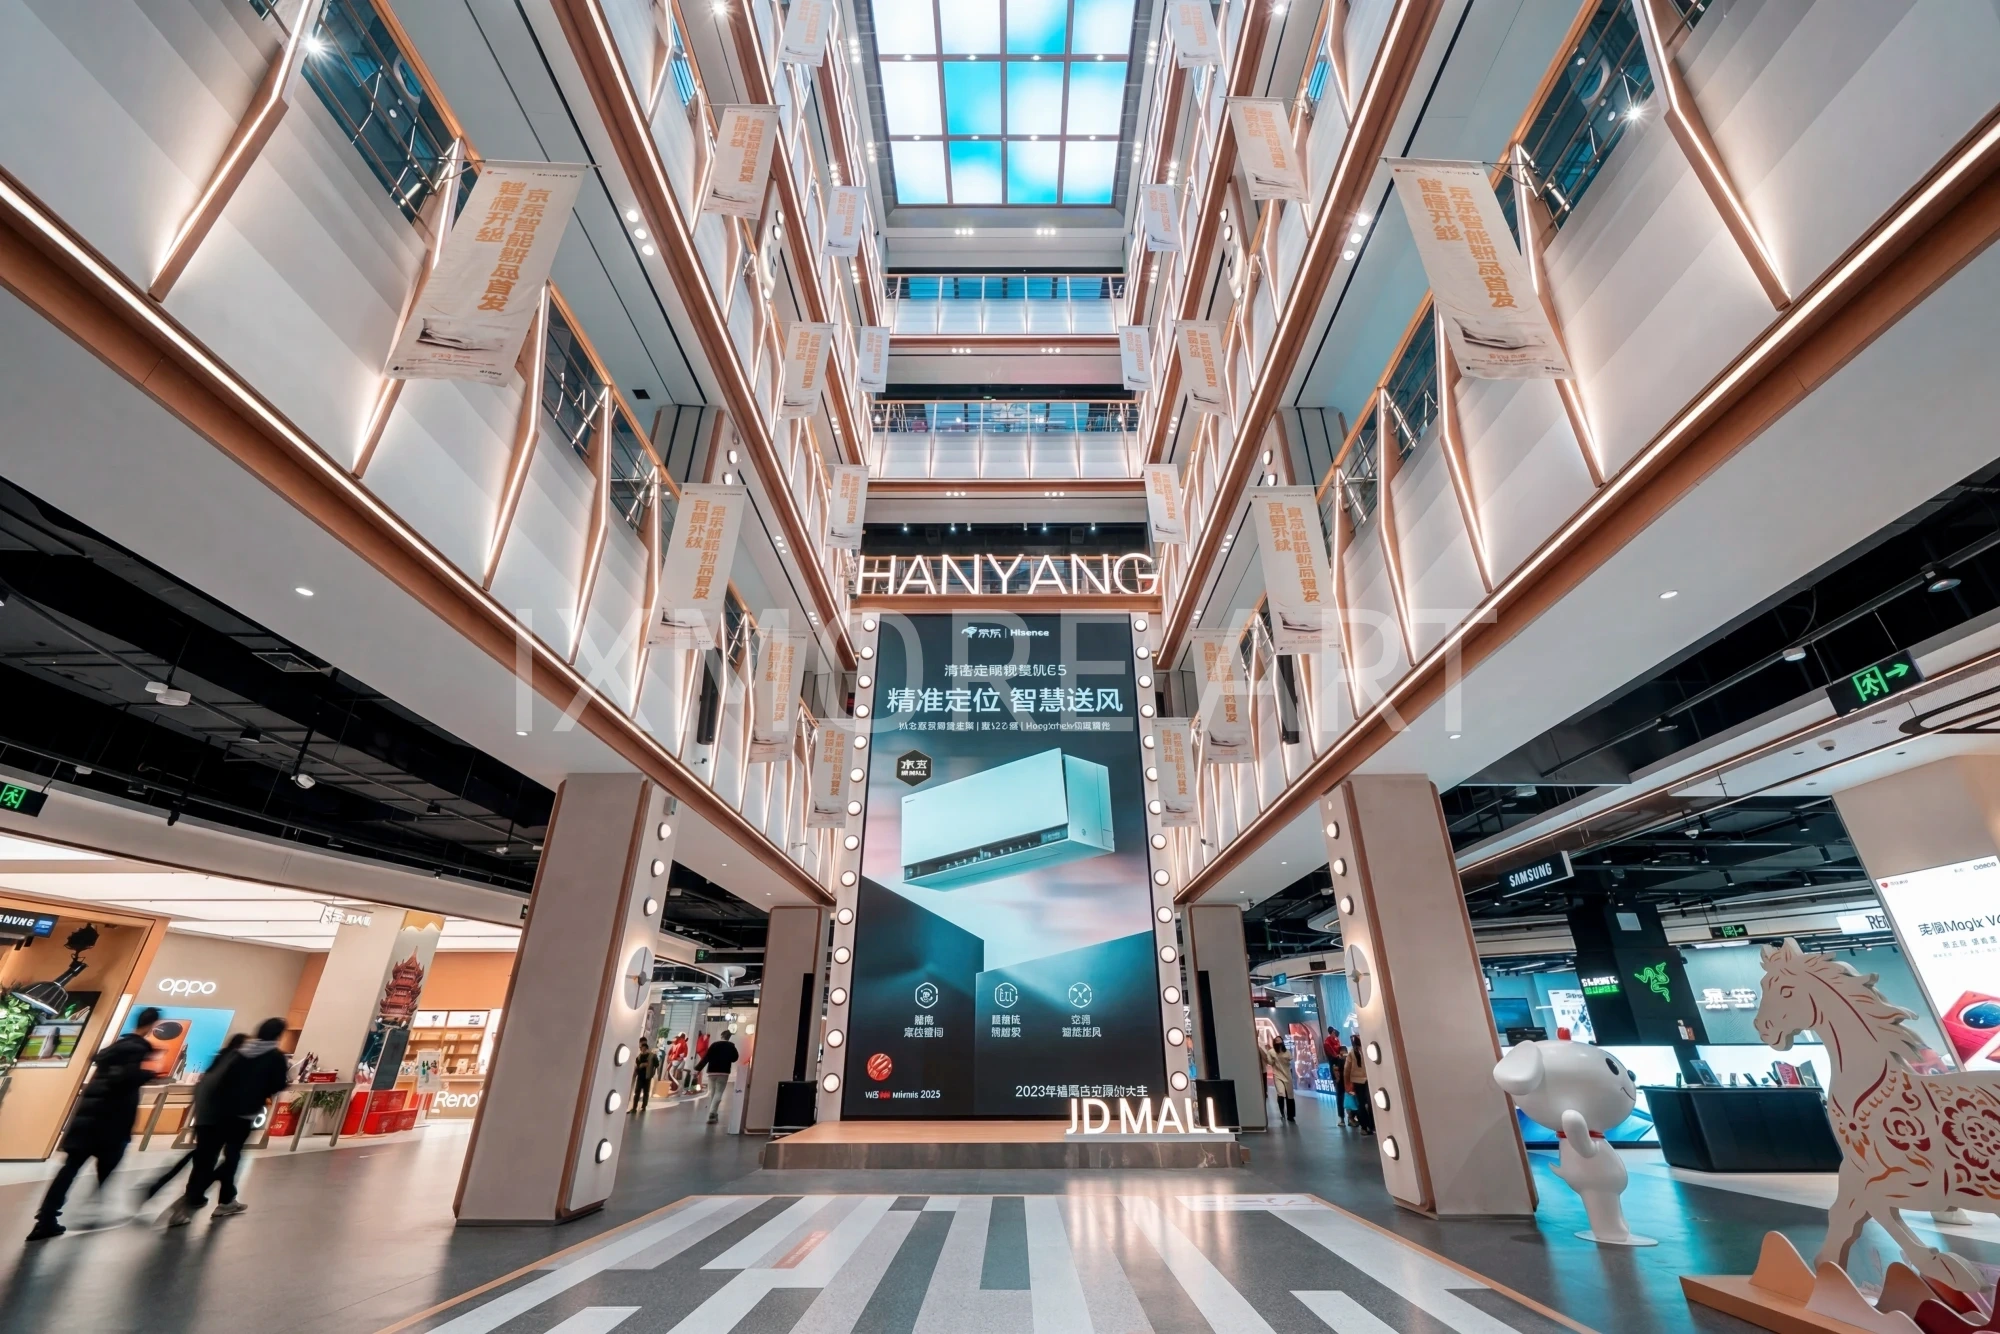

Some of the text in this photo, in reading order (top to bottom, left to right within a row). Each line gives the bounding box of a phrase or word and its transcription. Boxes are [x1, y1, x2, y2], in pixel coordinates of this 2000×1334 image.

[856, 553, 1160, 595] HANYANG
[887, 687, 1123, 713] 精准定位 智慧送风
[1509, 862, 1553, 888] SAMSUNG
[1065, 1097, 1230, 1135] JD MALL
